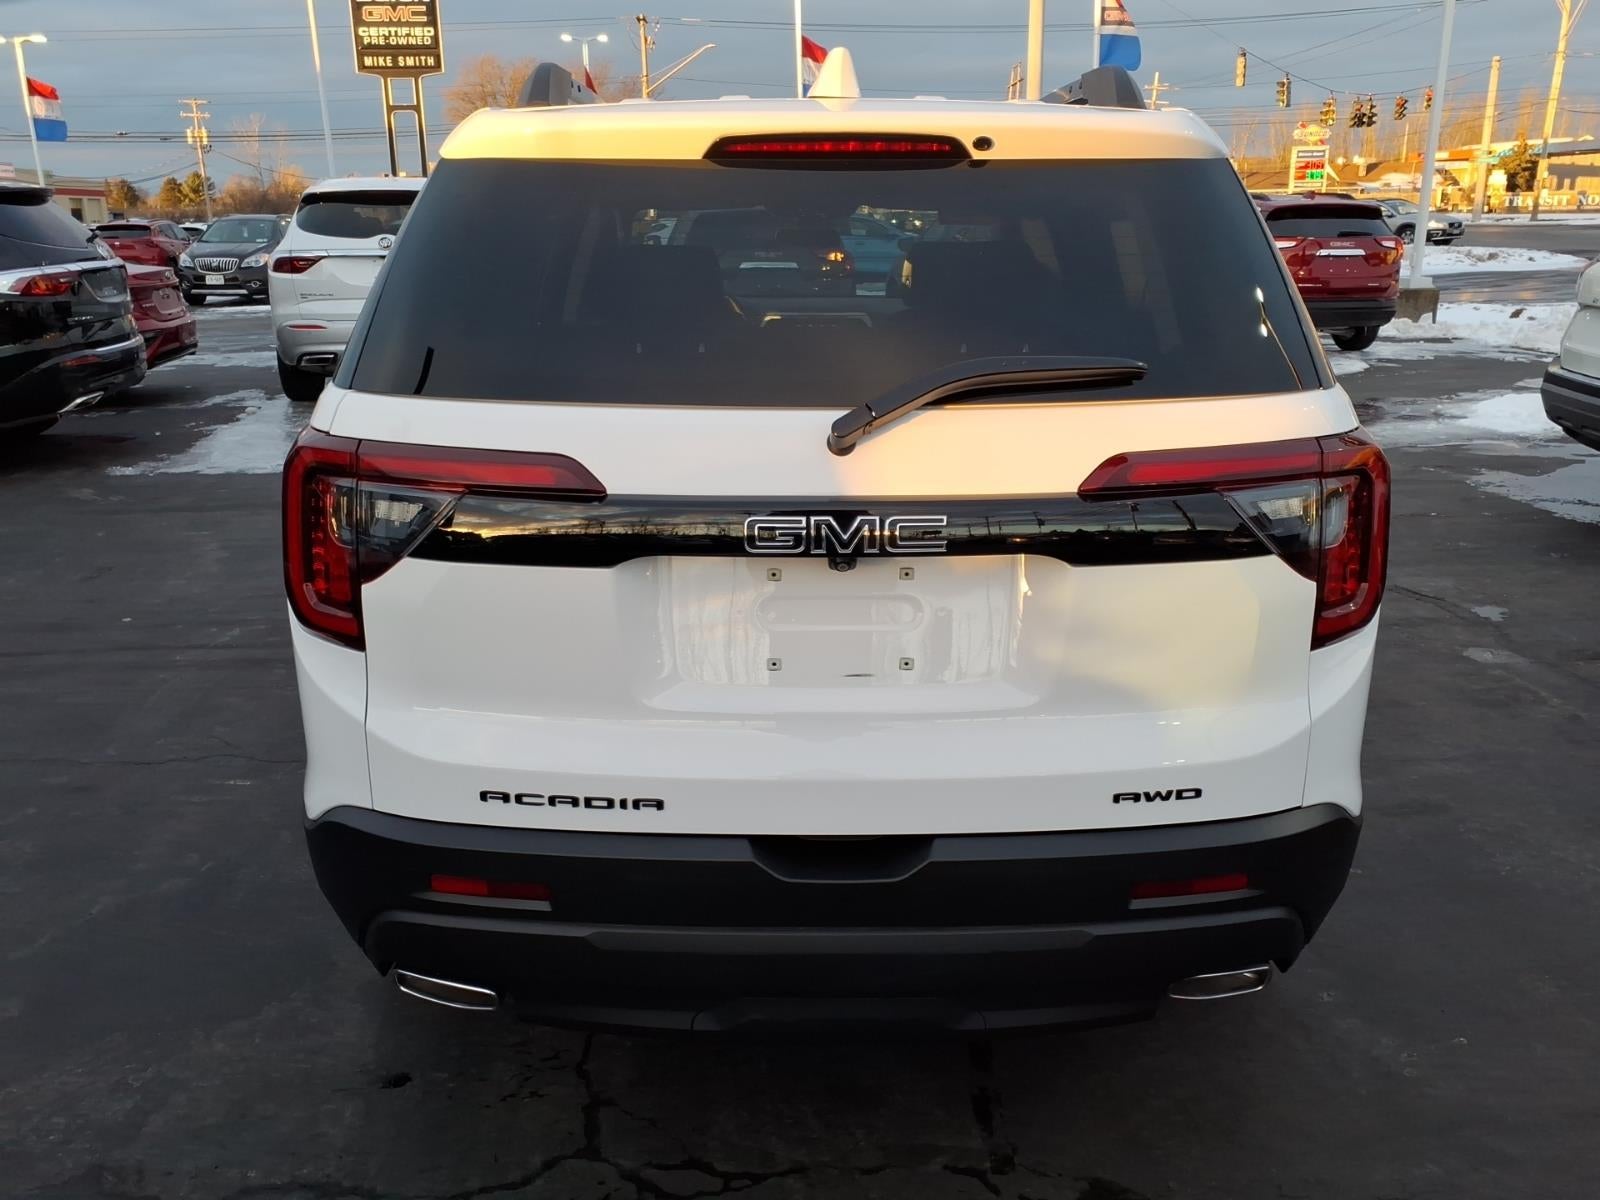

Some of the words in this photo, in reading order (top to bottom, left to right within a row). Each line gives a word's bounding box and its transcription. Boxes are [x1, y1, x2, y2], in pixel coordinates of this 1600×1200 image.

[362, 5, 428, 22] GMC
[358, 27, 435, 37] CERTIFIED
[363, 36, 432, 45] PRE-OWNED
[363, 56, 393, 67] MIKE
[398, 56, 435, 67] SMITH
[744, 515, 948, 554] GMC
[479, 790, 665, 812] ACADIA
[1112, 788, 1203, 804] AWD
